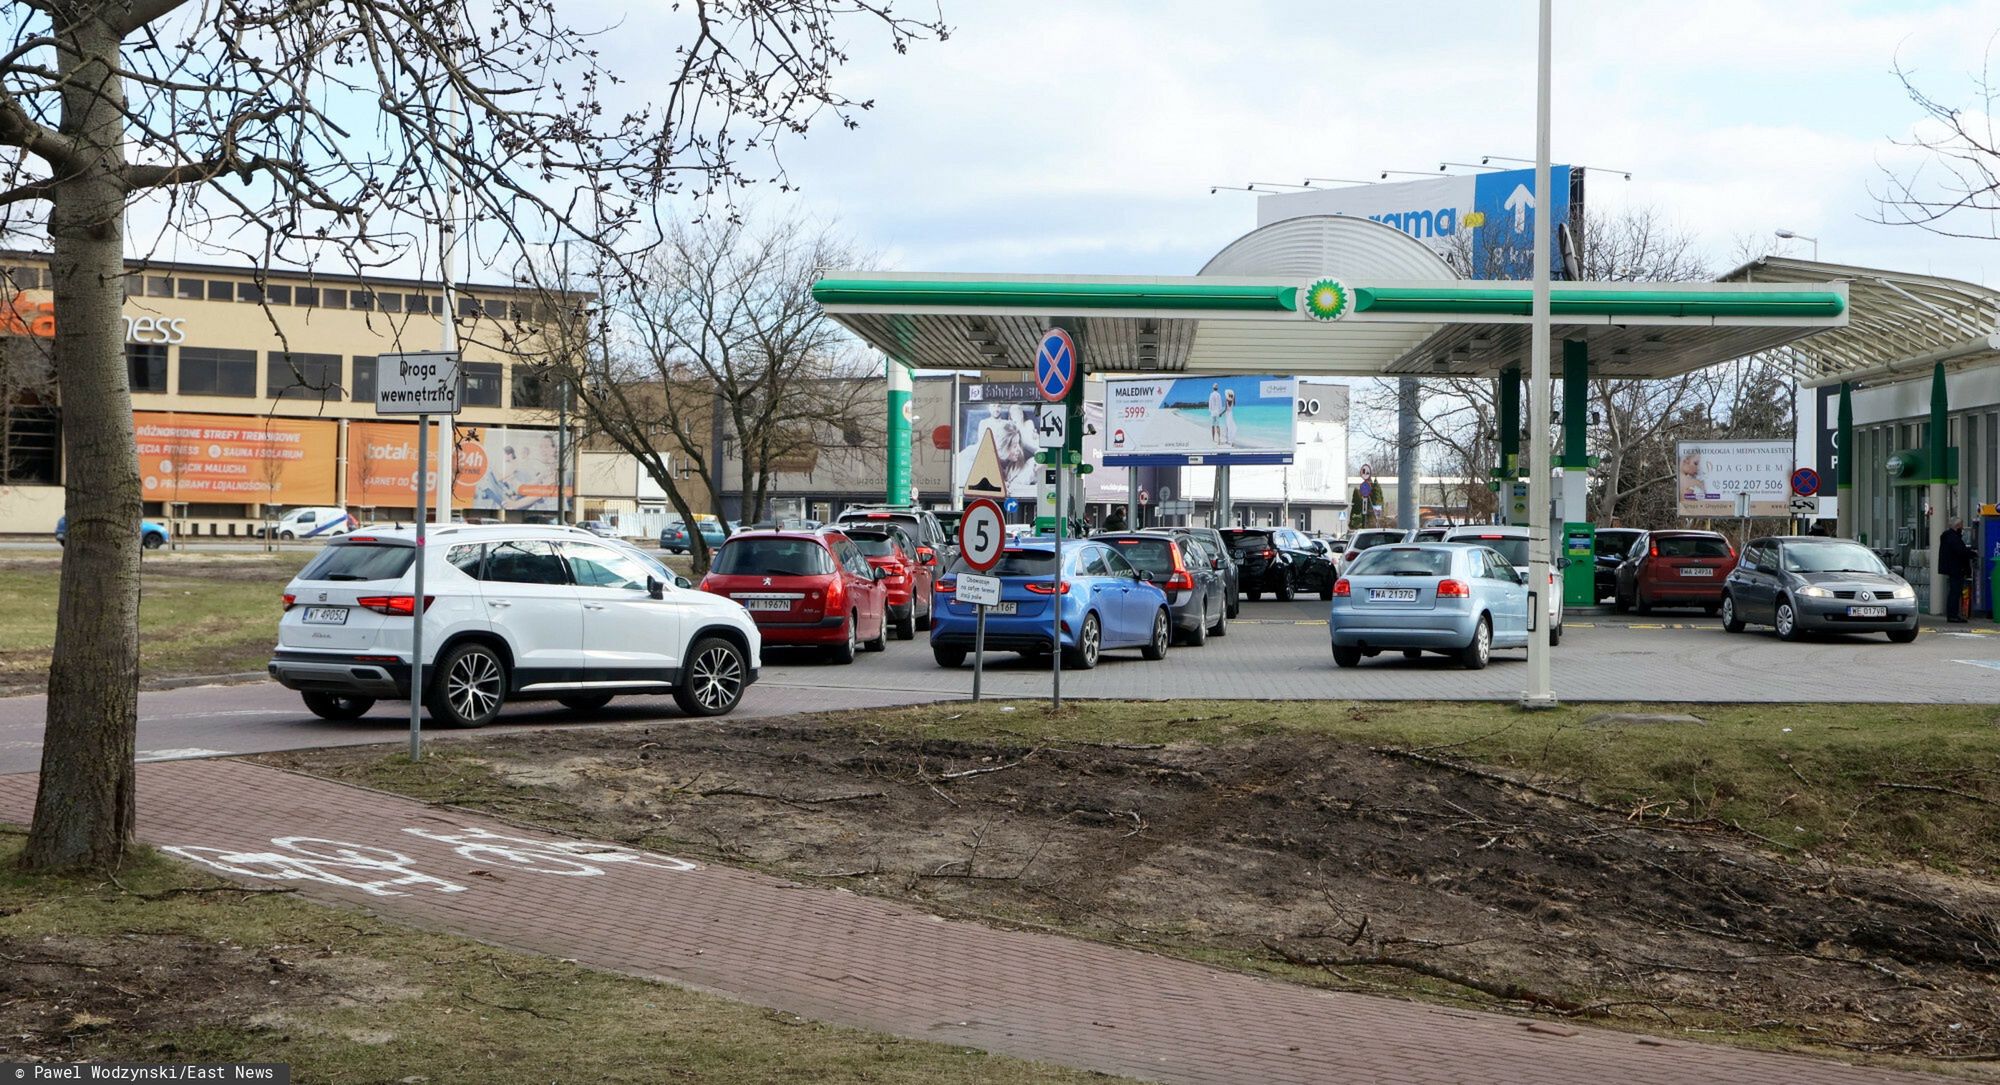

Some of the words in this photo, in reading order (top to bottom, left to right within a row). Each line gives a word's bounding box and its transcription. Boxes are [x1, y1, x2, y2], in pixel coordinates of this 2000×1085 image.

[400, 361, 436, 380] Droga
[381, 386, 455, 406] wewnętrzna
[1115, 386, 1154, 397] MALEDIWY
[1124, 406, 1145, 418] 5999
[203, 429, 239, 440] STREFY
[163, 446, 199, 456] FITNESS
[223, 449, 253, 458] SAUNA
[1683, 447, 1730, 455] DERMATOLOGIA
[1736, 447, 1769, 455] MEDYCYNA
[204, 464, 247, 474] MALUCHA
[1722, 480, 1739, 490] 502
[1744, 480, 1760, 490] 207
[1765, 480, 1783, 490] 506
[975, 520, 989, 552] 5
[1376, 588, 1386, 598] WA
[1389, 588, 1414, 598] 2137G
[750, 600, 760, 608] WI
[764, 600, 789, 608] 1967N
[307, 609, 319, 619] WT
[320, 609, 345, 620] 4905C
[1852, 607, 1861, 617] WE
